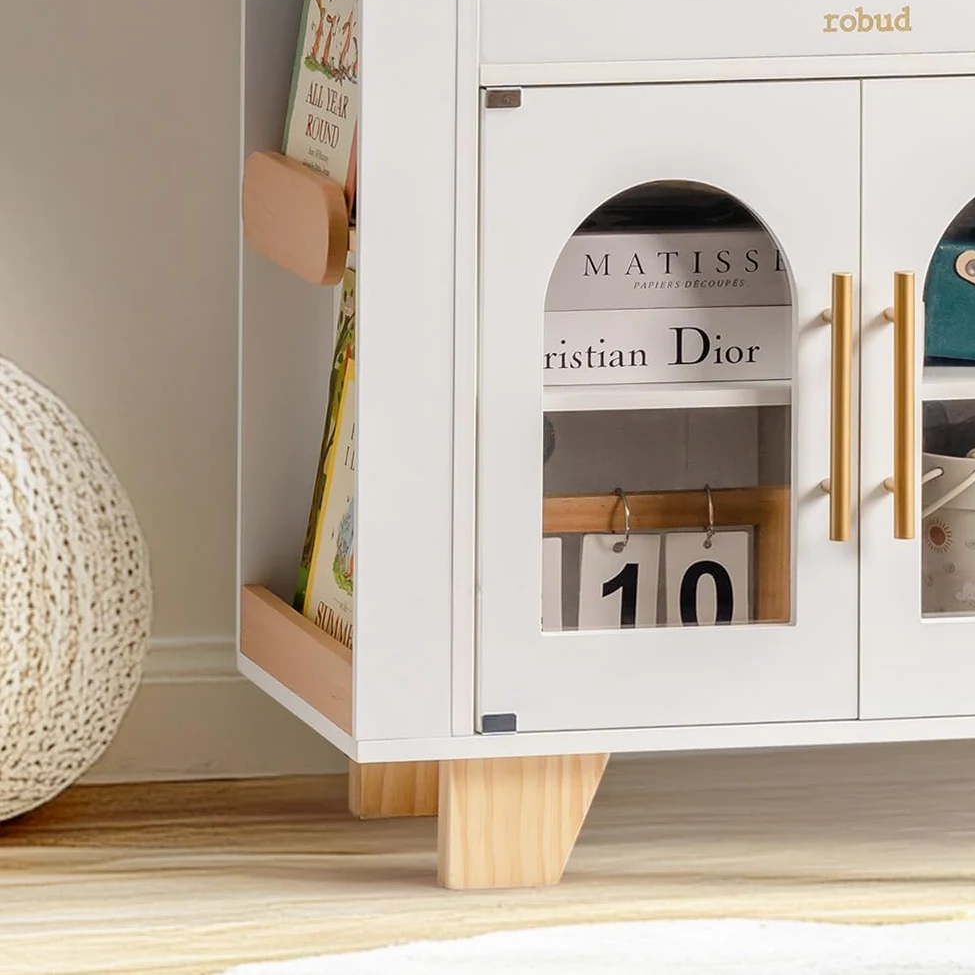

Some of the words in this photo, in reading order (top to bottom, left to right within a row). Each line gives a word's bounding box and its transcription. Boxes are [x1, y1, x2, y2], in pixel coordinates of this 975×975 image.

[822, 6, 912, 33] robud
[305, 81, 324, 109] ALL
[325, 87, 349, 119] YEAR
[305, 113, 340, 149] ROUND
[633, 280, 680, 290] PAPIERS
[667, 327, 761, 366] Dior
